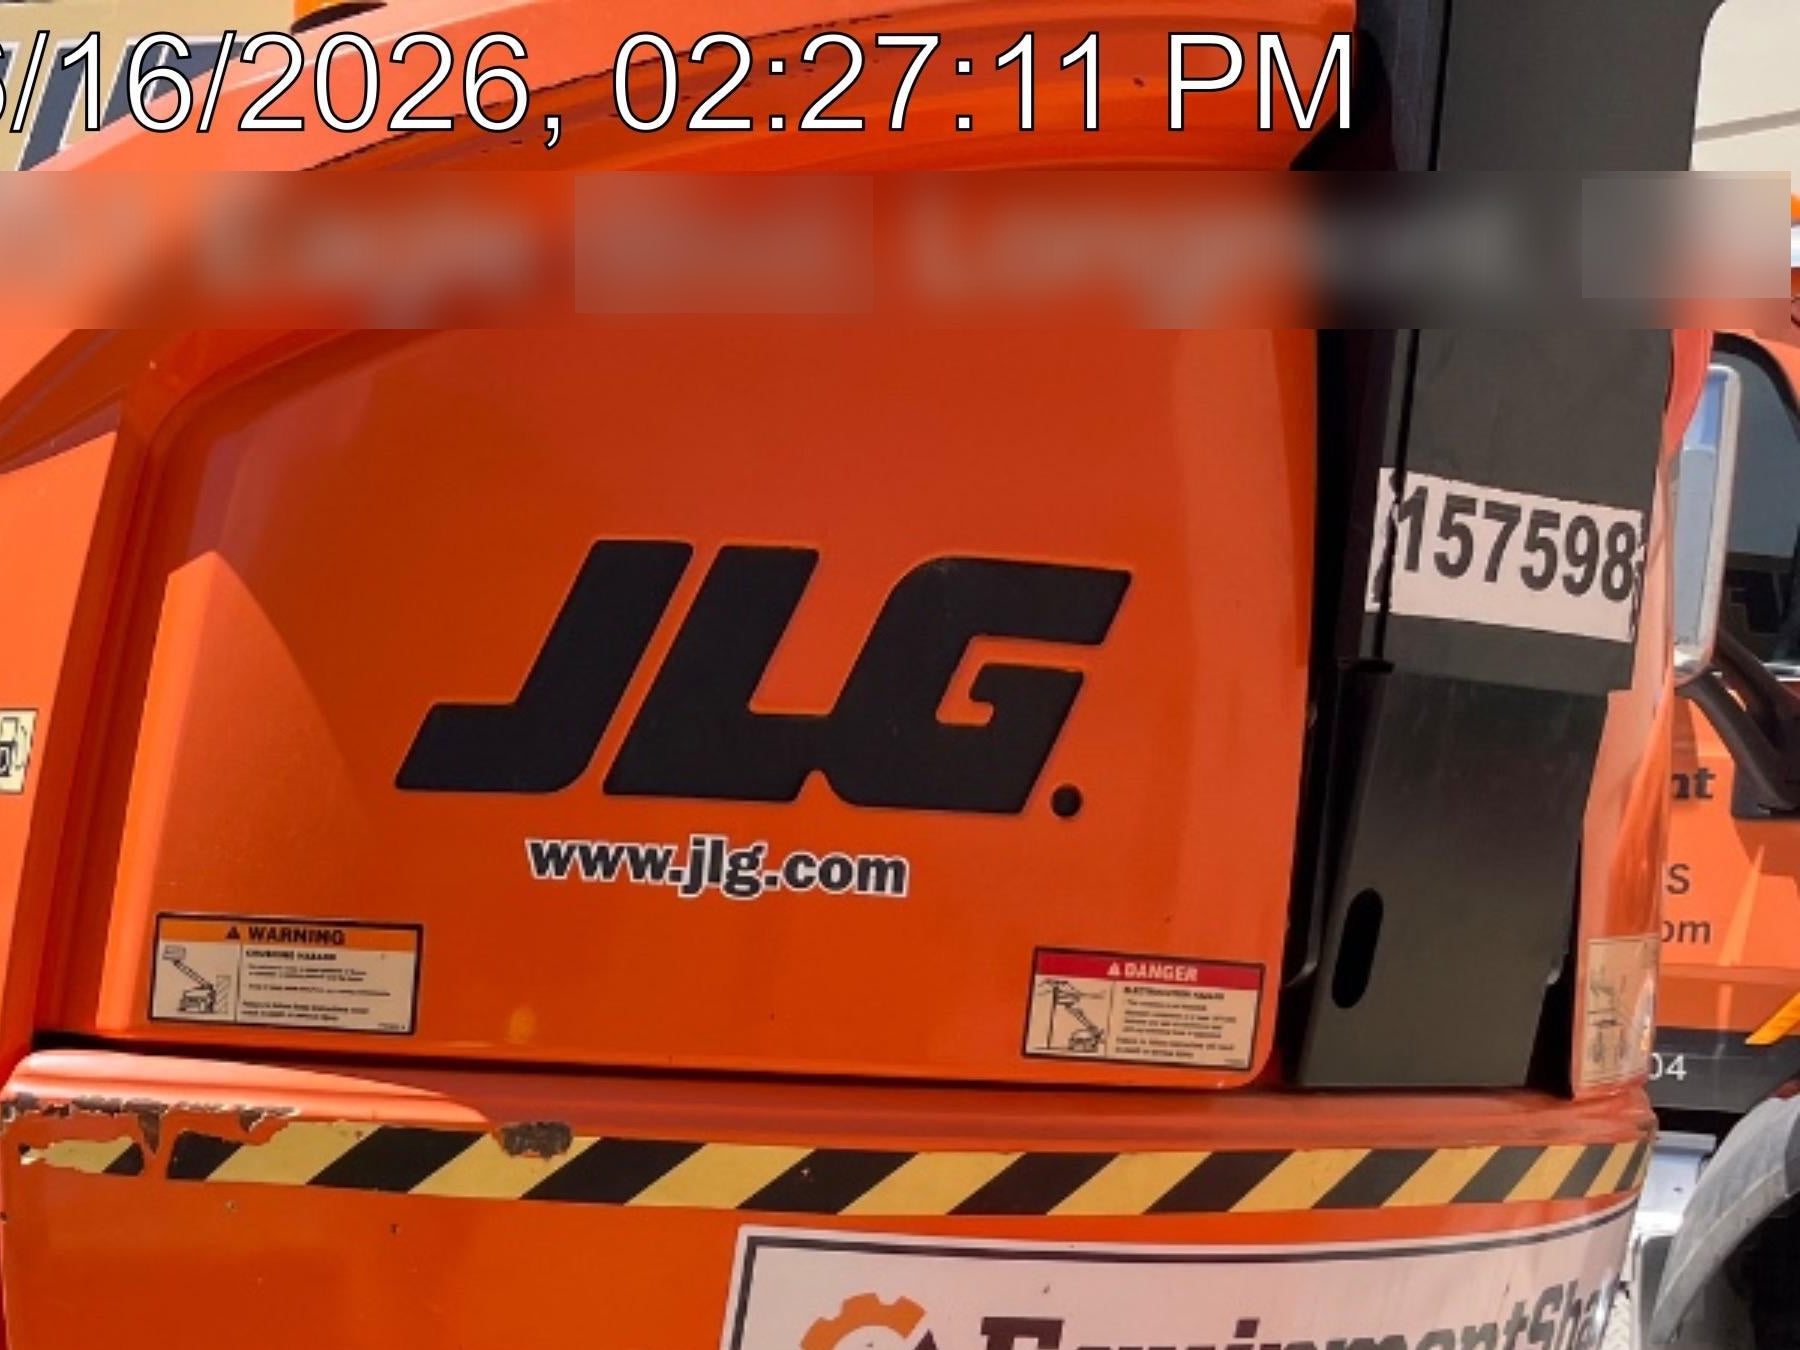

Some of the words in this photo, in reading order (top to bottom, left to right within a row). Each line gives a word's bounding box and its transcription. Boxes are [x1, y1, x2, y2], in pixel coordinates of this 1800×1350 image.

[1397, 485, 1638, 603] 157598
[526, 835, 910, 900] www.jlg.com
[247, 926, 345, 946] WARNING
[1124, 964, 1199, 982] DANGER
